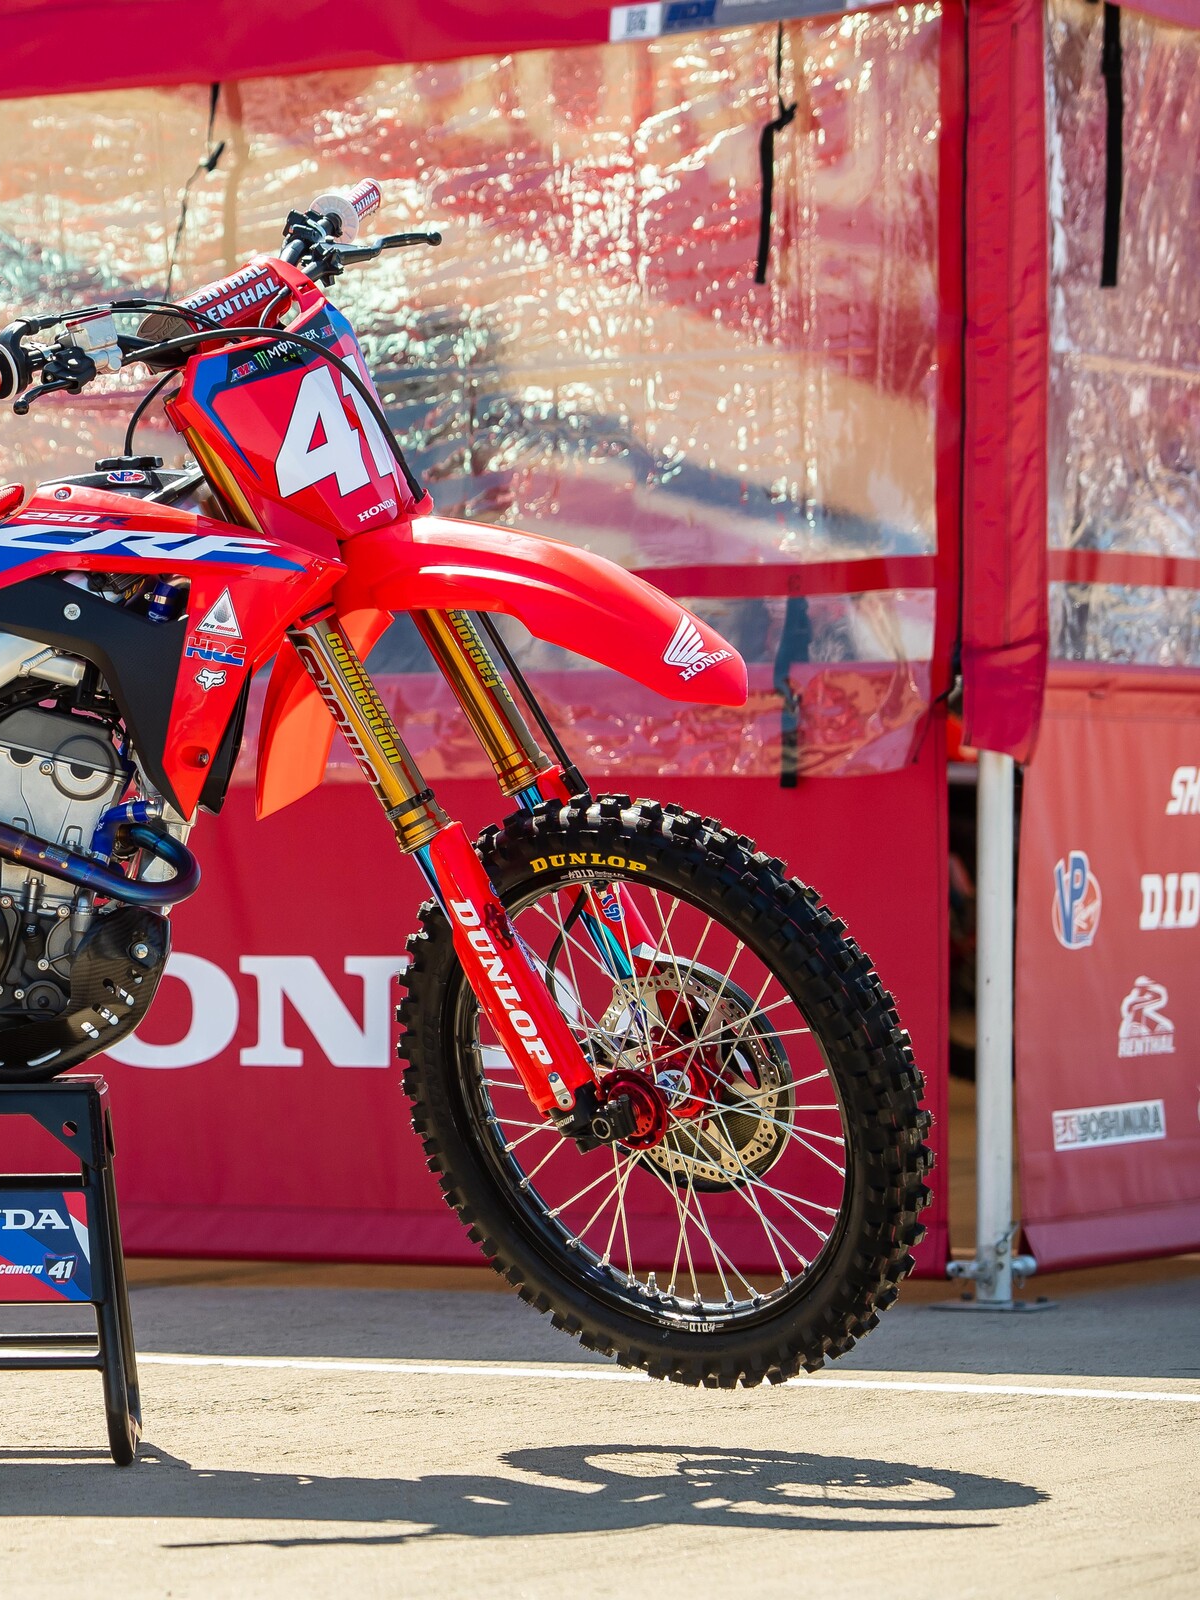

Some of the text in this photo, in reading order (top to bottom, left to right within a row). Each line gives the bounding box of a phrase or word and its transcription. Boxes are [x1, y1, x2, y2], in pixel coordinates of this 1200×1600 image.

[354, 190, 379, 212] NTHAL
[181, 264, 268, 310] RENTHAL
[267, 329, 320, 359] MONER
[282, 347, 313, 362] ENER
[230, 361, 258, 382] AMA
[274, 354, 394, 499] 41
[357, 498, 396, 522] HONDA
[185, 636, 247, 666] HRC
[679, 649, 733, 681] HONDA
[530, 853, 647, 873] DUNLOP
[450, 898, 553, 1065] DUNLOP
[48, 1261, 74, 1278] 41
